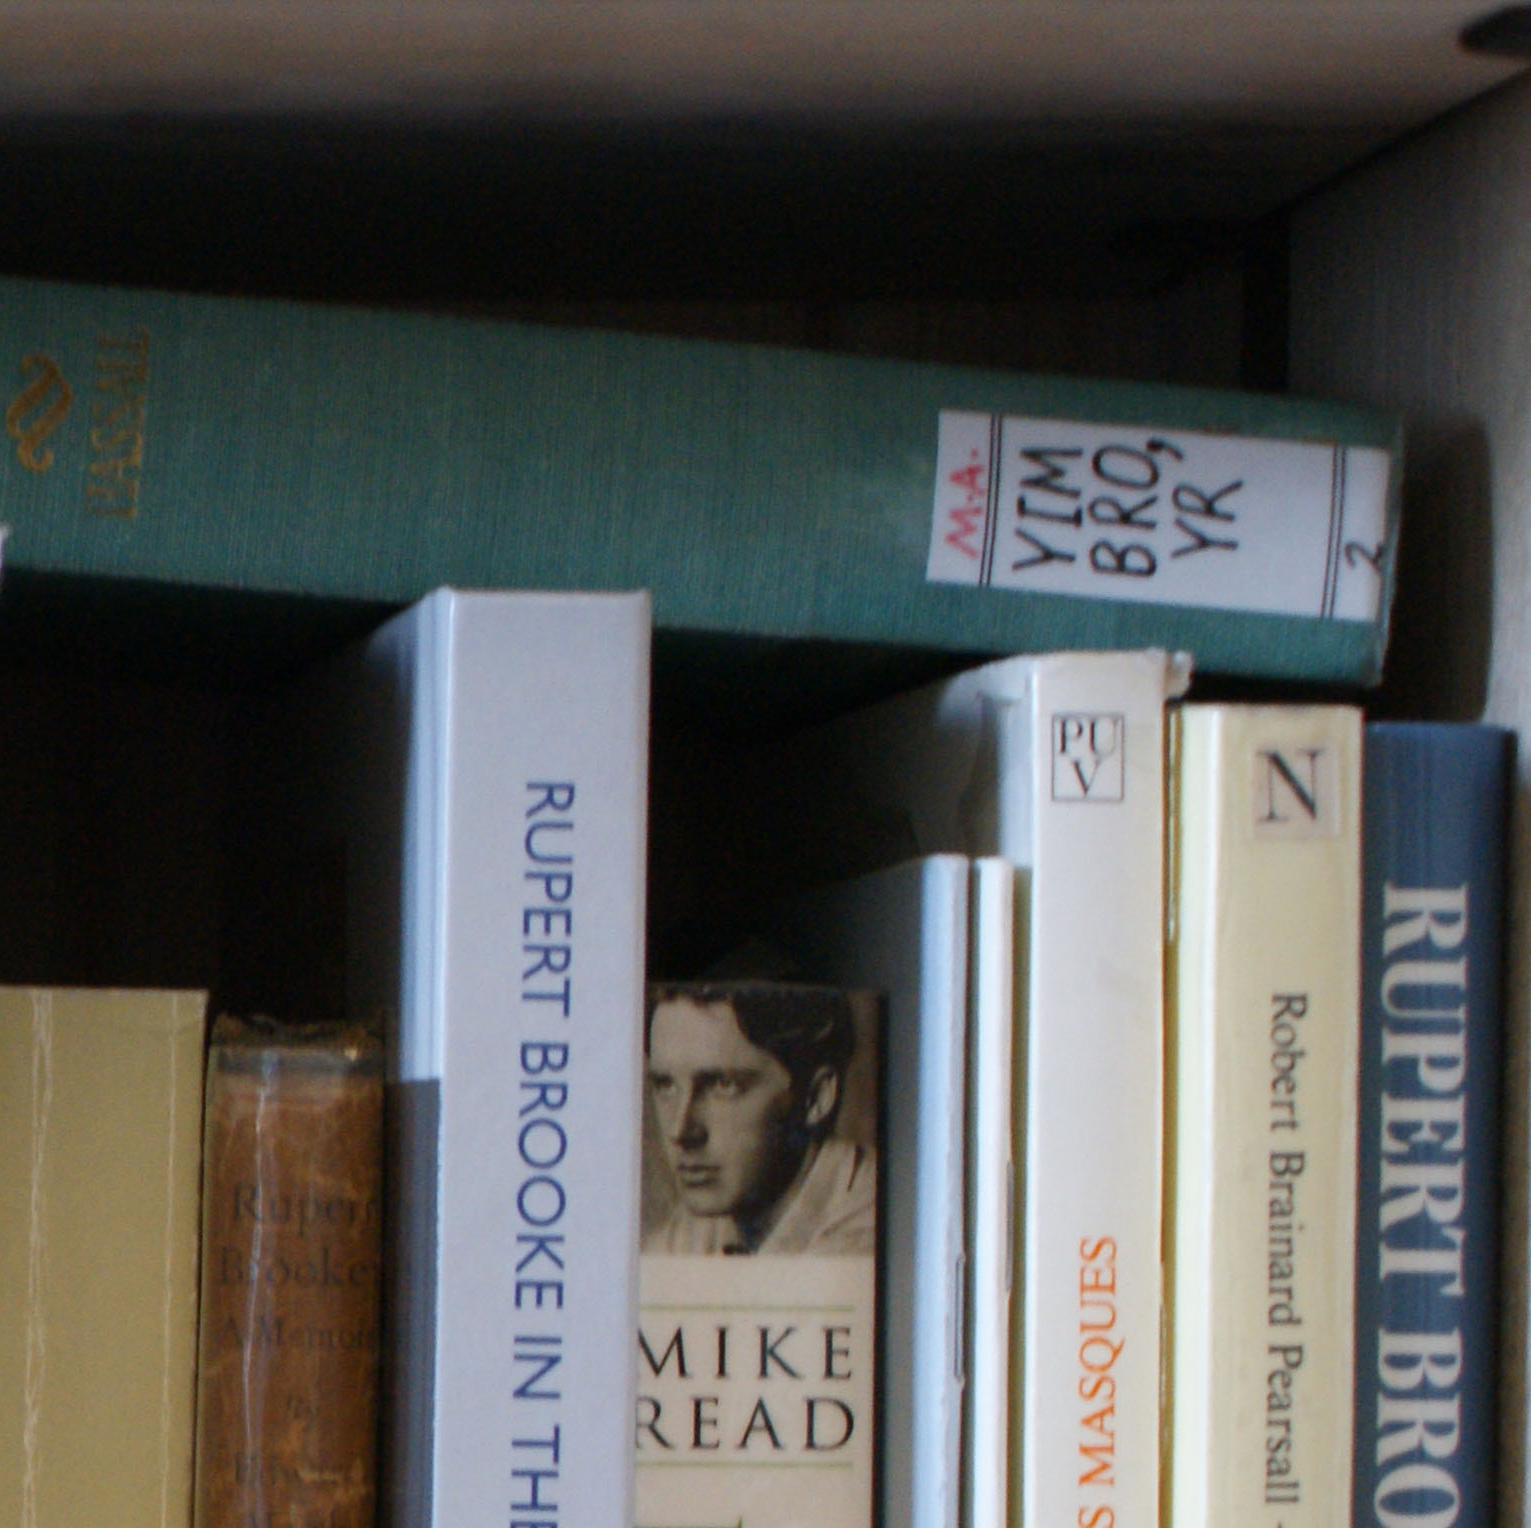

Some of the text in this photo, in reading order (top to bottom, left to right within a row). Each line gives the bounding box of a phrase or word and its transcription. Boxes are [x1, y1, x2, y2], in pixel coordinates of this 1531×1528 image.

[1011, 444, 1085, 572] YIM
[1087, 435, 1186, 581] BRO,
[1169, 478, 1244, 560] YR
[1256, 746, 1325, 825] N
[519, 779, 577, 1019] RUPERT
[1269, 990, 1310, 1134] Robert
[1379, 880, 1470, 1298] RUPERT
[513, 1040, 571, 1310] BROOKE
[1267, 1151, 1307, 1328] Brainard
[511, 1333, 564, 1400] IN
[633, 1395, 857, 1453] READ
[636, 1325, 854, 1383] MIKE
[1077, 1235, 1127, 1488] MASQUES
[1263, 1343, 1306, 1507] Pearsall
